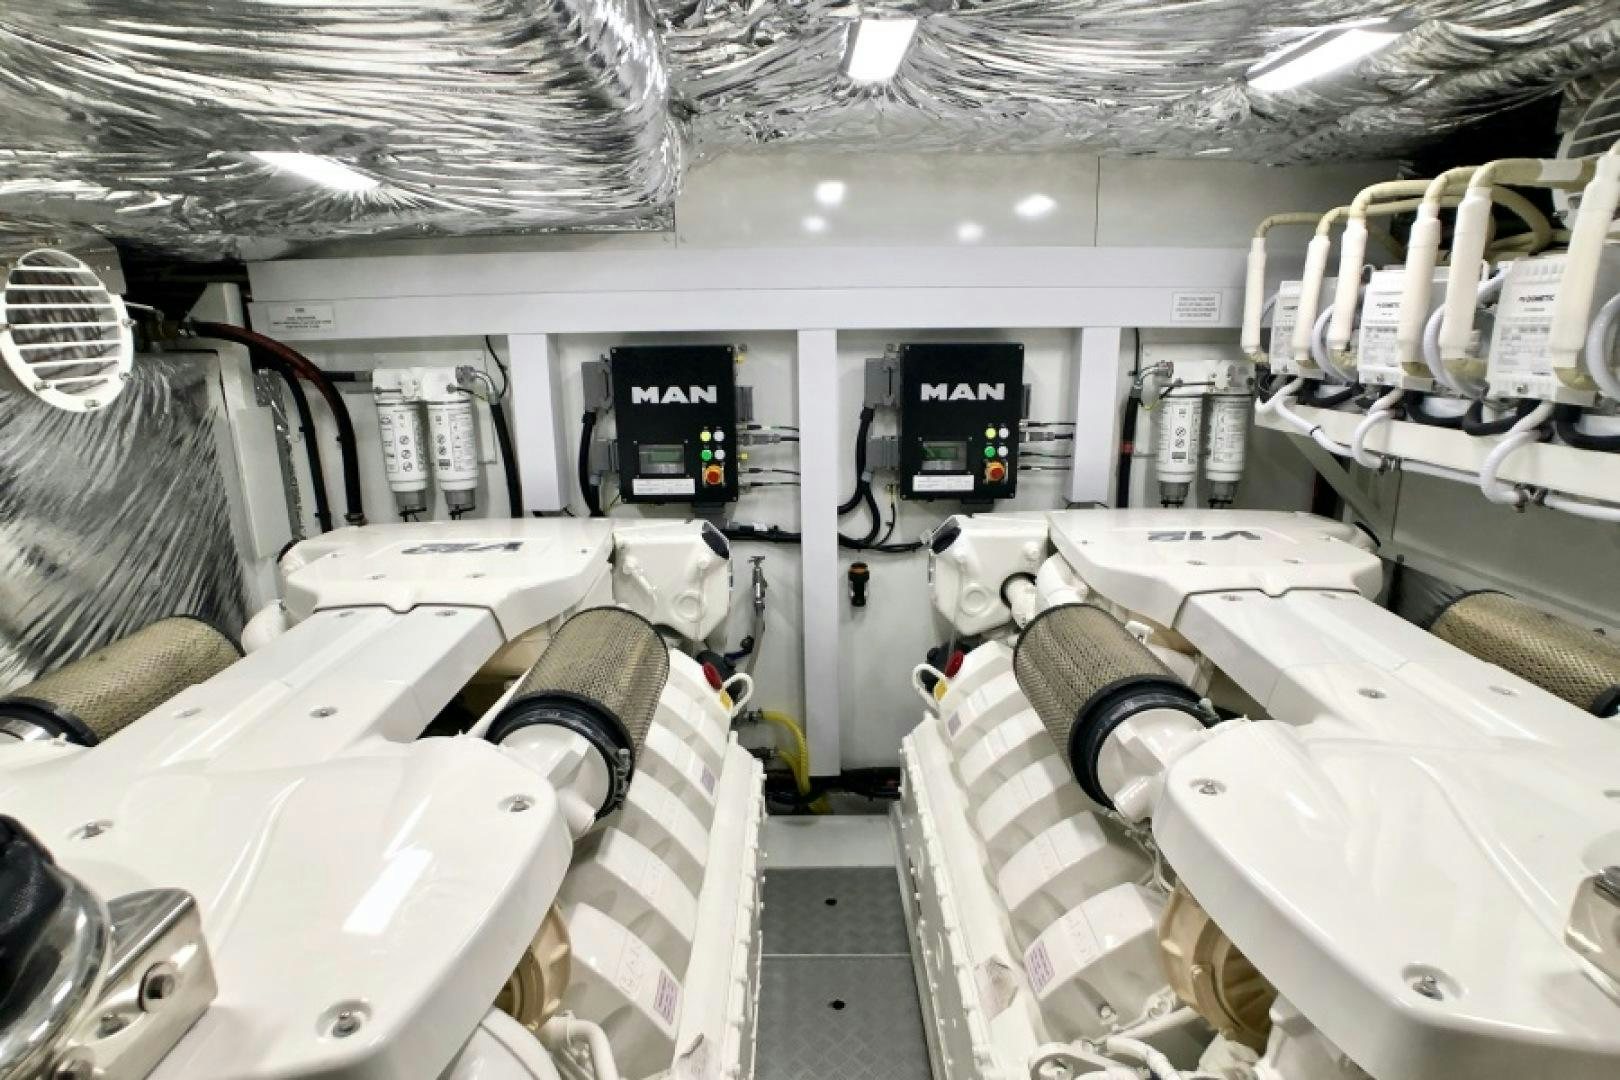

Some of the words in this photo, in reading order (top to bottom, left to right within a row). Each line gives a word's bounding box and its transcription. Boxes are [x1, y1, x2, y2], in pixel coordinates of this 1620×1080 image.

[631, 386, 717, 404] MAN
[922, 383, 1005, 401] MAN
[1147, 530, 1260, 541] V12
